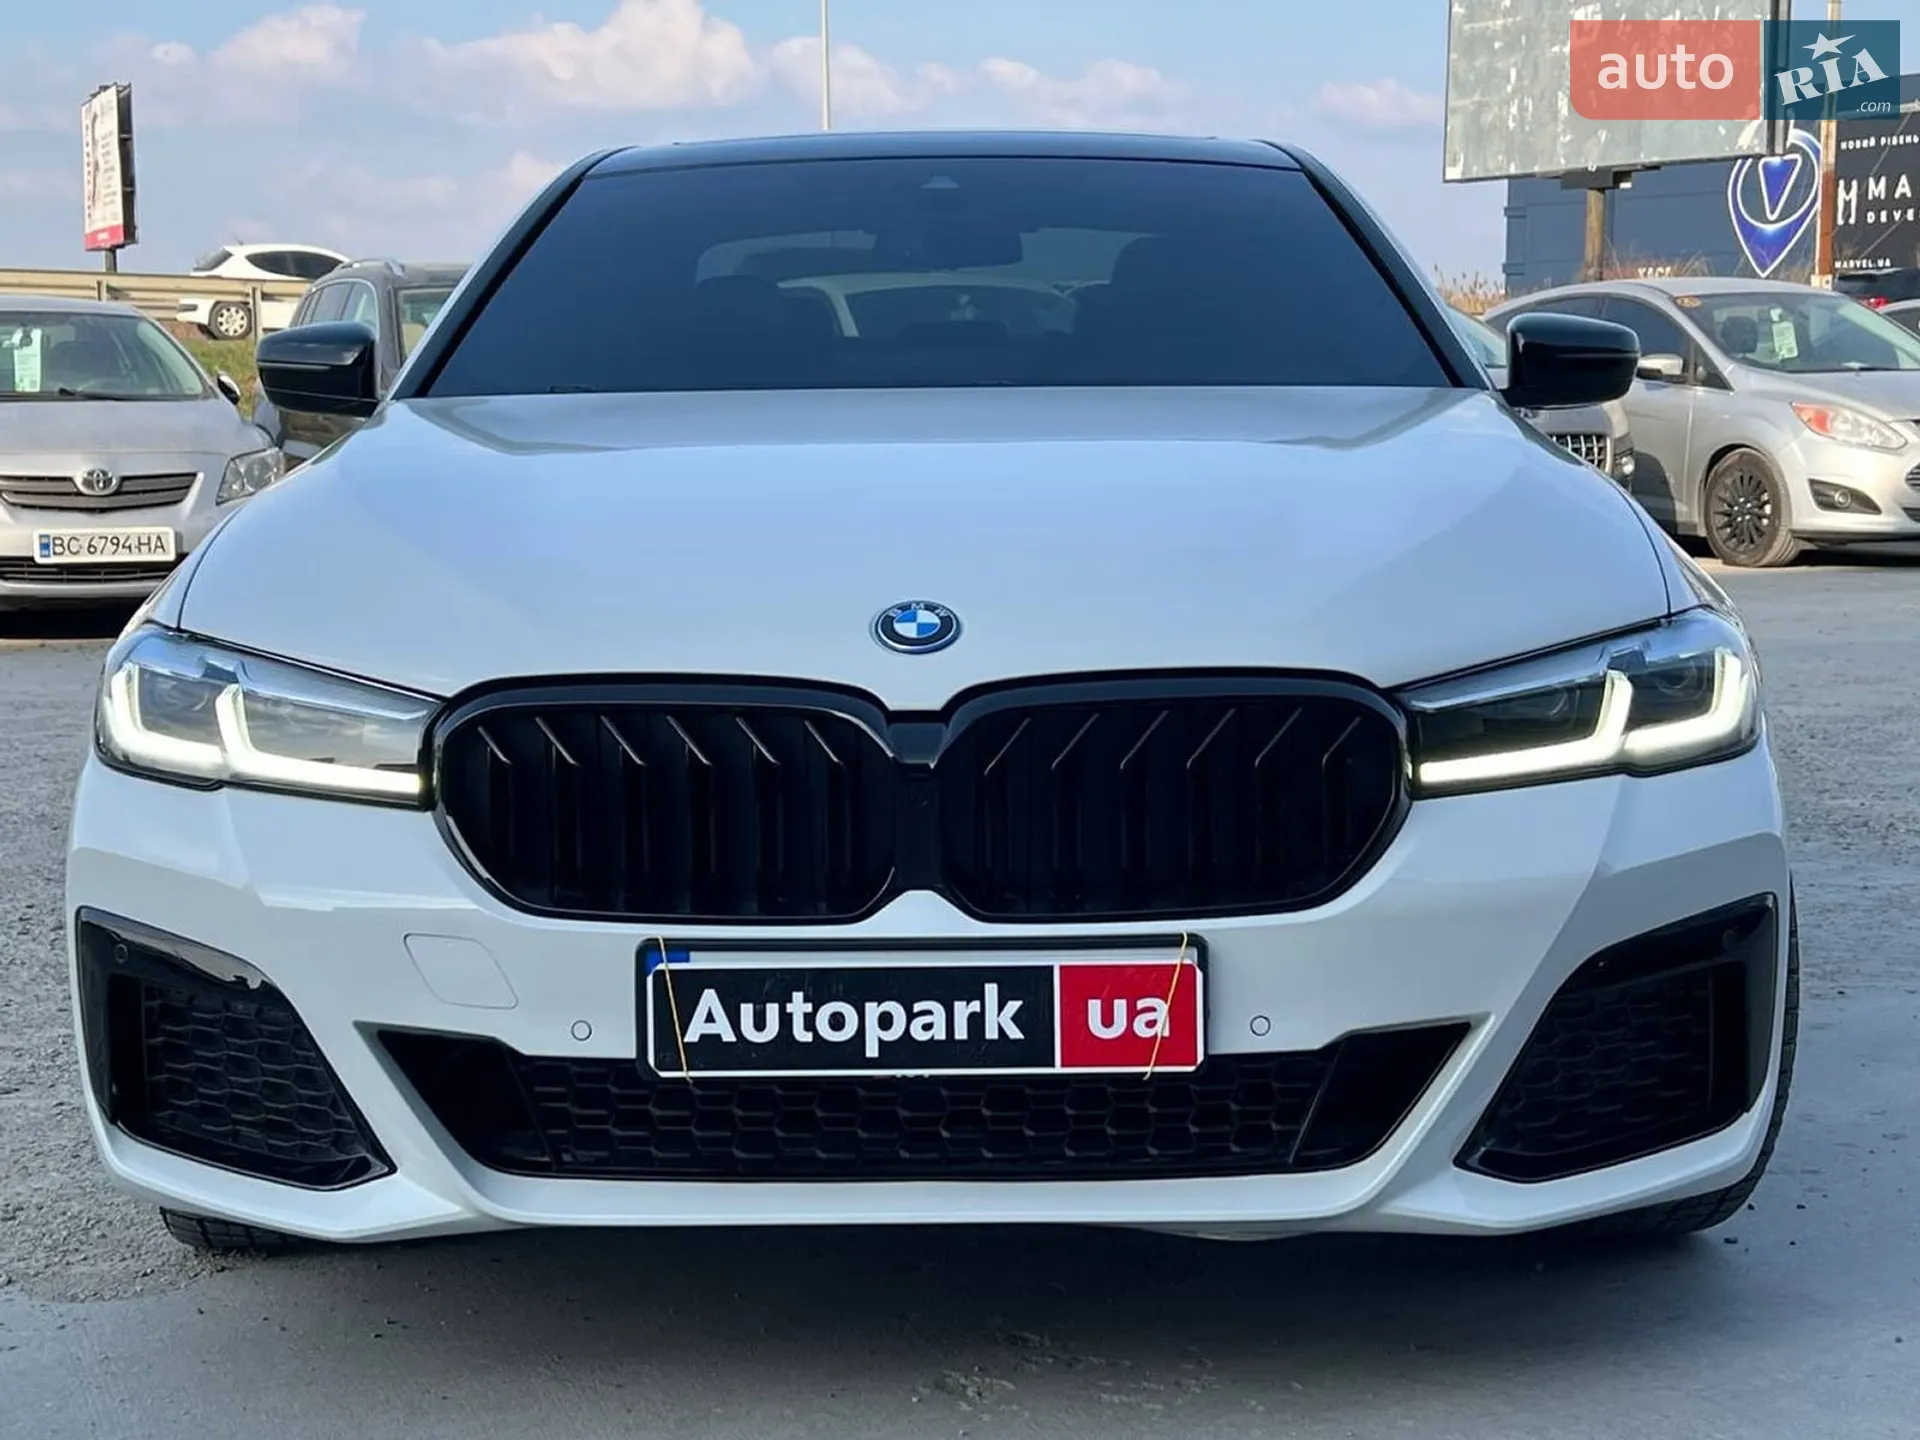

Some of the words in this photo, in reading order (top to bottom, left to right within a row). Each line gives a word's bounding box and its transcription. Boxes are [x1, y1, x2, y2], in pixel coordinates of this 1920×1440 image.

[1867, 208, 1920, 224] DEVE
[87, 535, 132, 555] 6794
[683, 982, 1025, 1058] Autopark
[1087, 997, 1171, 1040] ua
